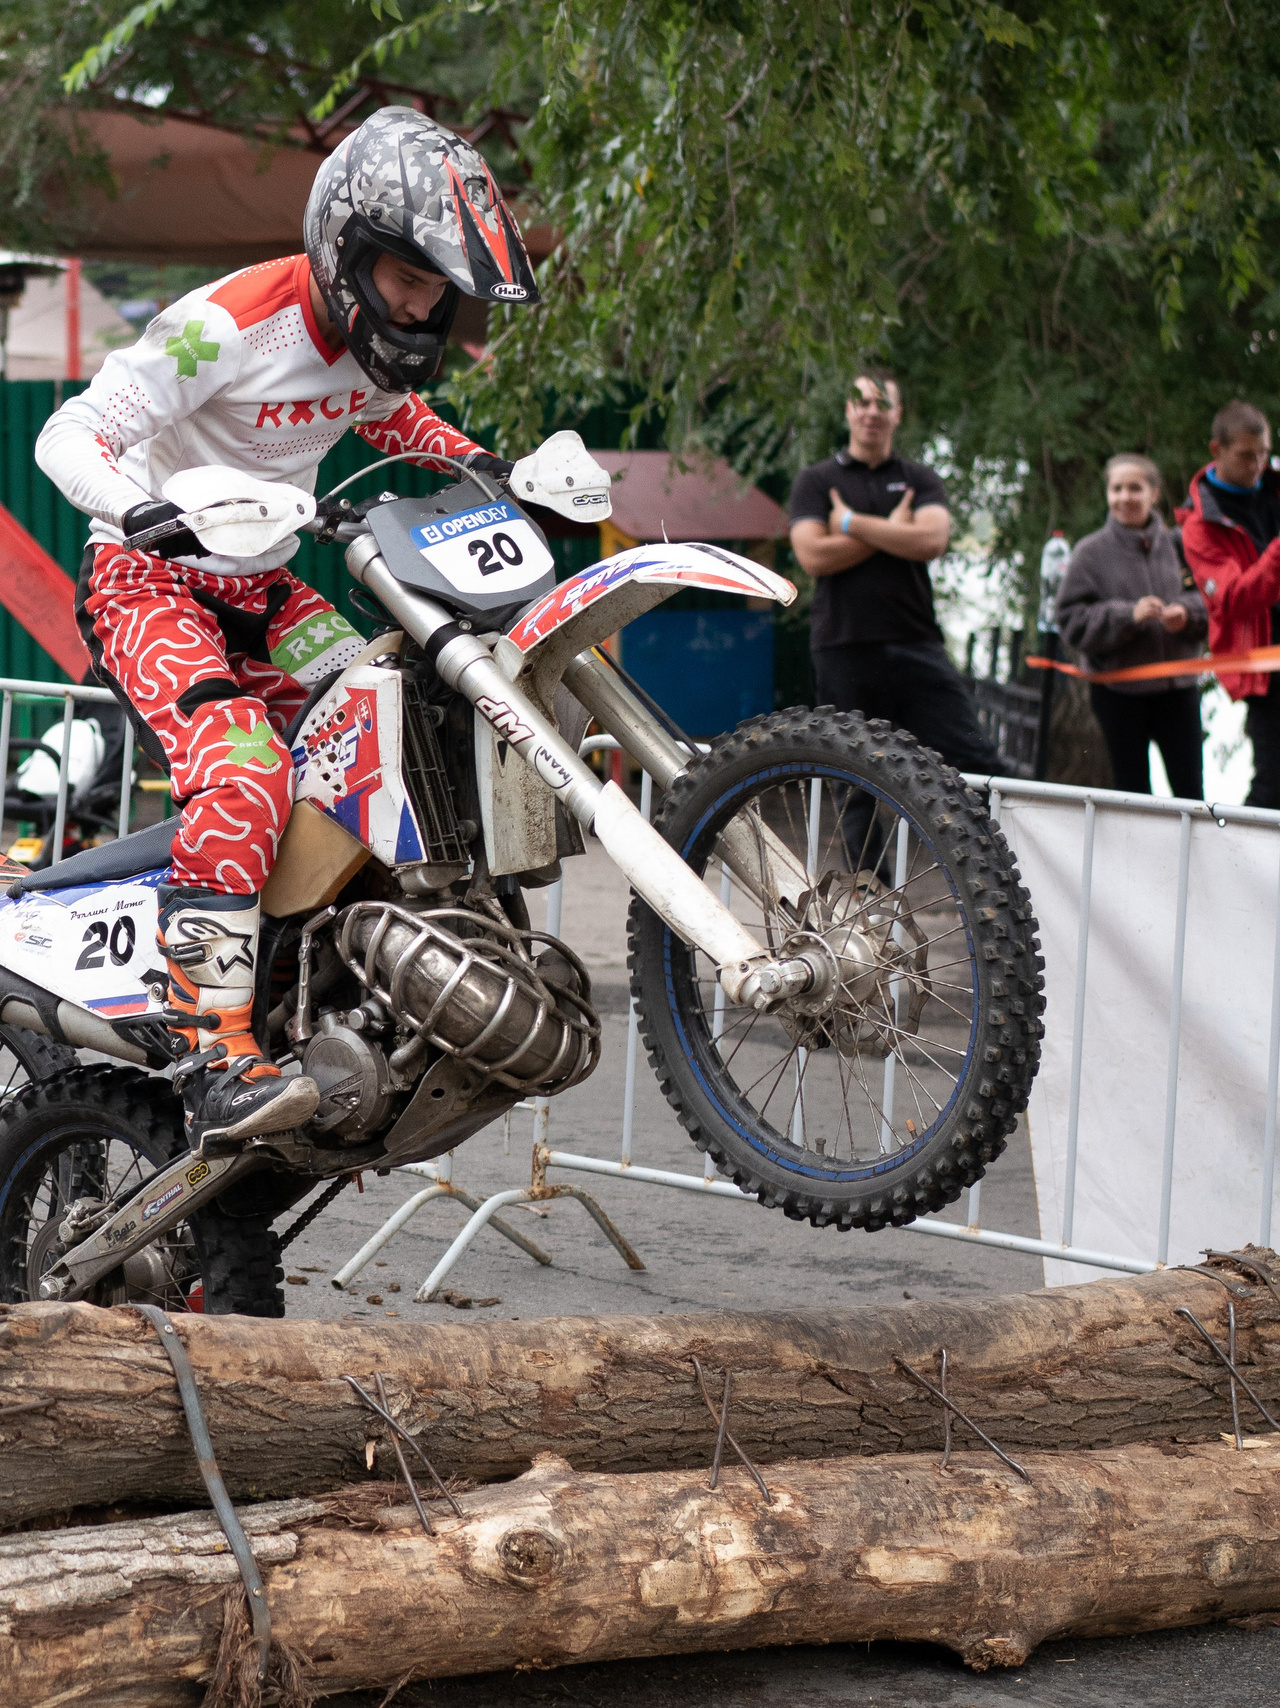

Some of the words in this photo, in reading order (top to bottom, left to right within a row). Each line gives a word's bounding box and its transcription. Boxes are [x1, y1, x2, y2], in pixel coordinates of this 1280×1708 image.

[497, 286, 525, 297] HJC
[442, 505, 508, 537] OPENDEV
[467, 531, 524, 577] 20
[285, 616, 353, 662] RXC
[539, 748, 571, 781] MAN
[75, 915, 137, 971] 20
[113, 1220, 137, 1244] Beta
